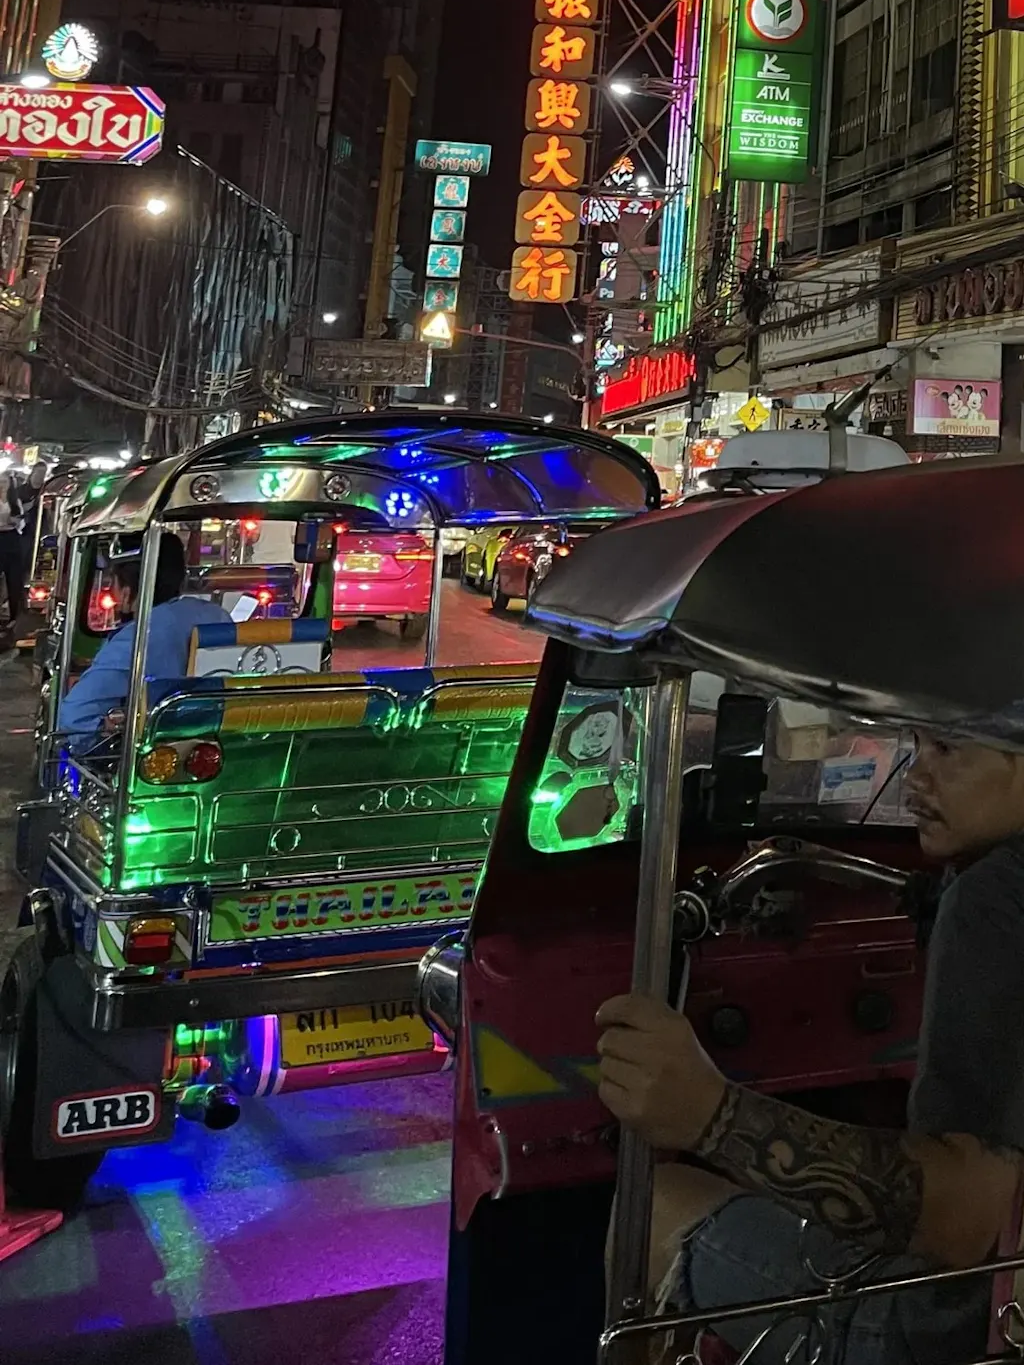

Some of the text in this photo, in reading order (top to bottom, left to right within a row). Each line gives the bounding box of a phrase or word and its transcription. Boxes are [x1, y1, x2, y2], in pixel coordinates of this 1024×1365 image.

[756, 85, 791, 102] ATM
[741, 113, 804, 128] EXCHANGE
[740, 136, 799, 151] WISDOM
[306, 1032, 411, 1059] กรุงเทพมหานคร
[61, 1094, 151, 1135] ARB
